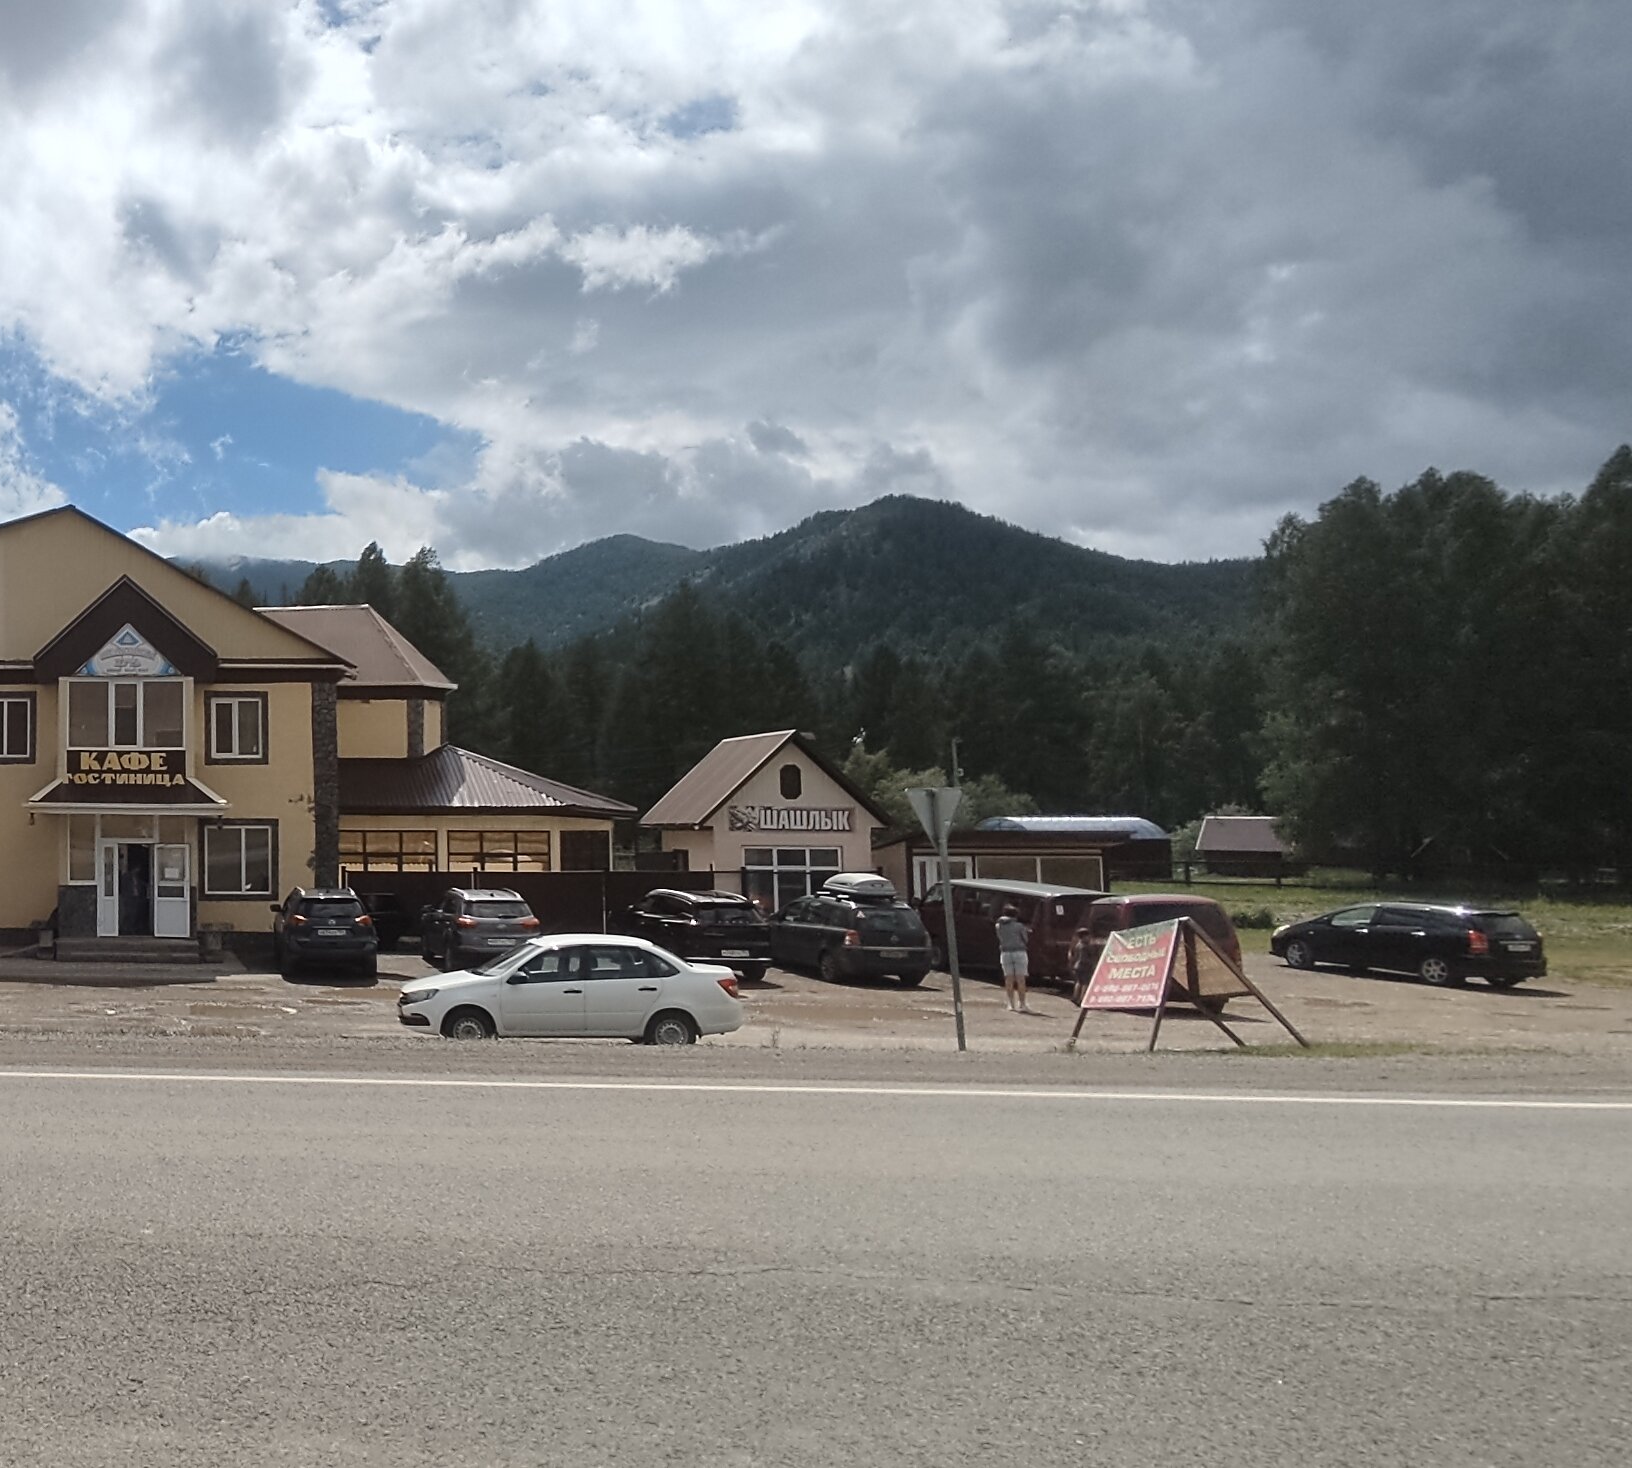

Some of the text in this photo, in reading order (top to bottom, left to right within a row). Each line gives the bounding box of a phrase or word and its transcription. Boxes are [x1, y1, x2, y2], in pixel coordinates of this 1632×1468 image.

[80, 751, 168, 771] КАФЕ
[62, 773, 185, 787] ГОСТИНИЦА
[759, 808, 851, 831] ШАШЛЫК
[1126, 933, 1156, 950] ЕСТЬ
[1108, 965, 1156, 979] МЕСТА
